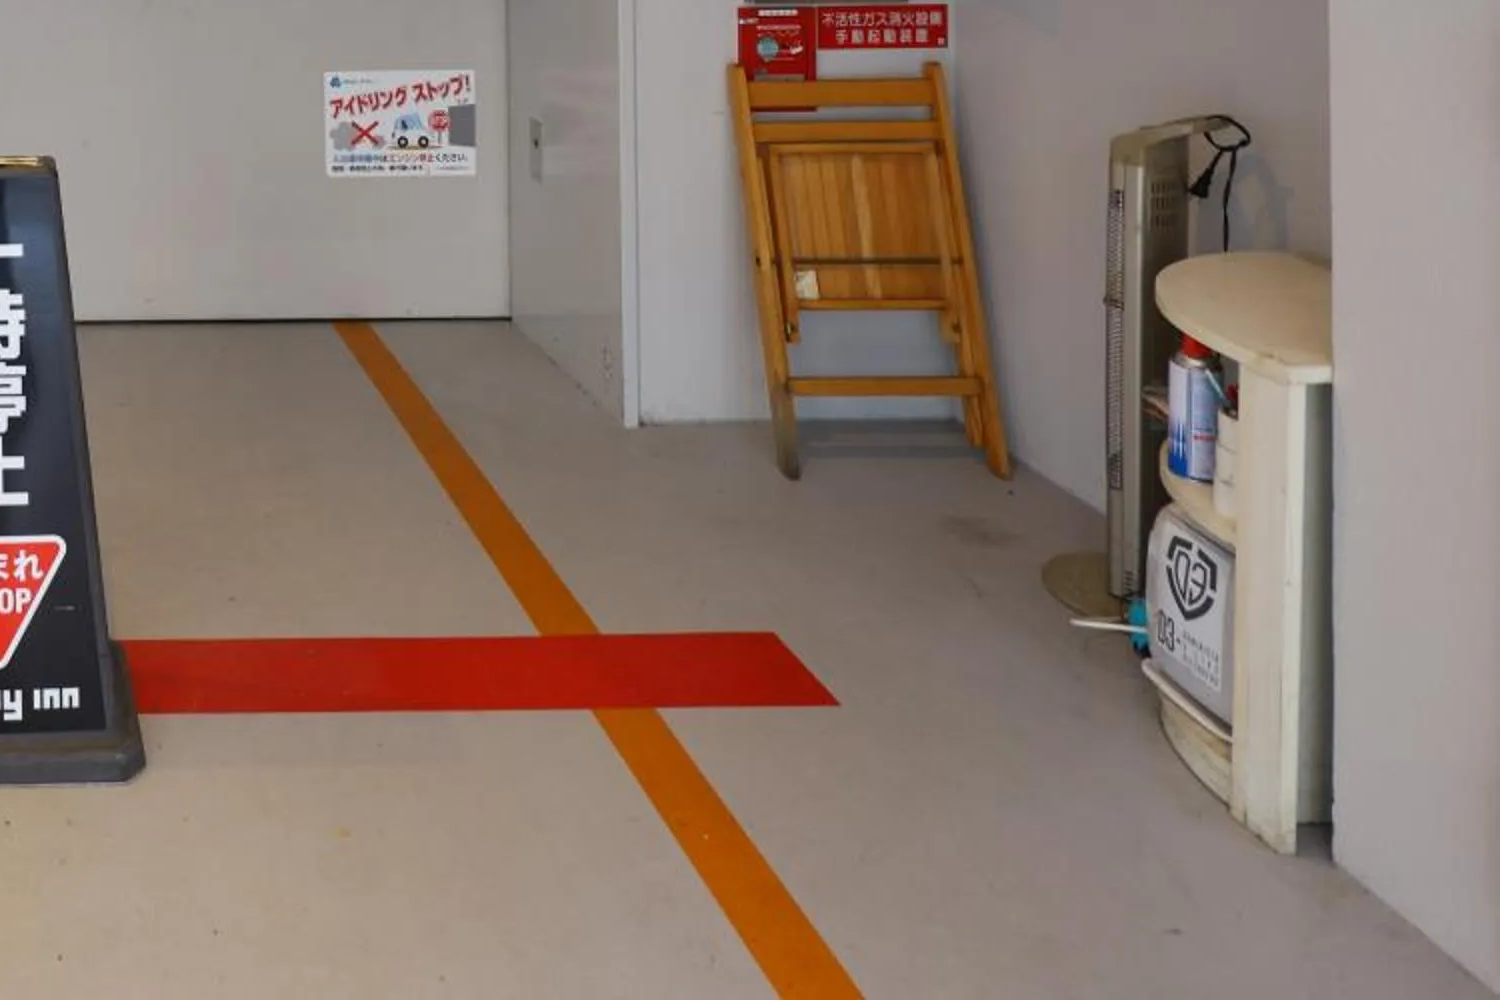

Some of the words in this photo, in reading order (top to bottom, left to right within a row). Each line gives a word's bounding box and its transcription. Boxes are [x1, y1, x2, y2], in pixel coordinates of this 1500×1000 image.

[330, 87, 407, 118] アイドリング
[34, 687, 80, 710] inn
